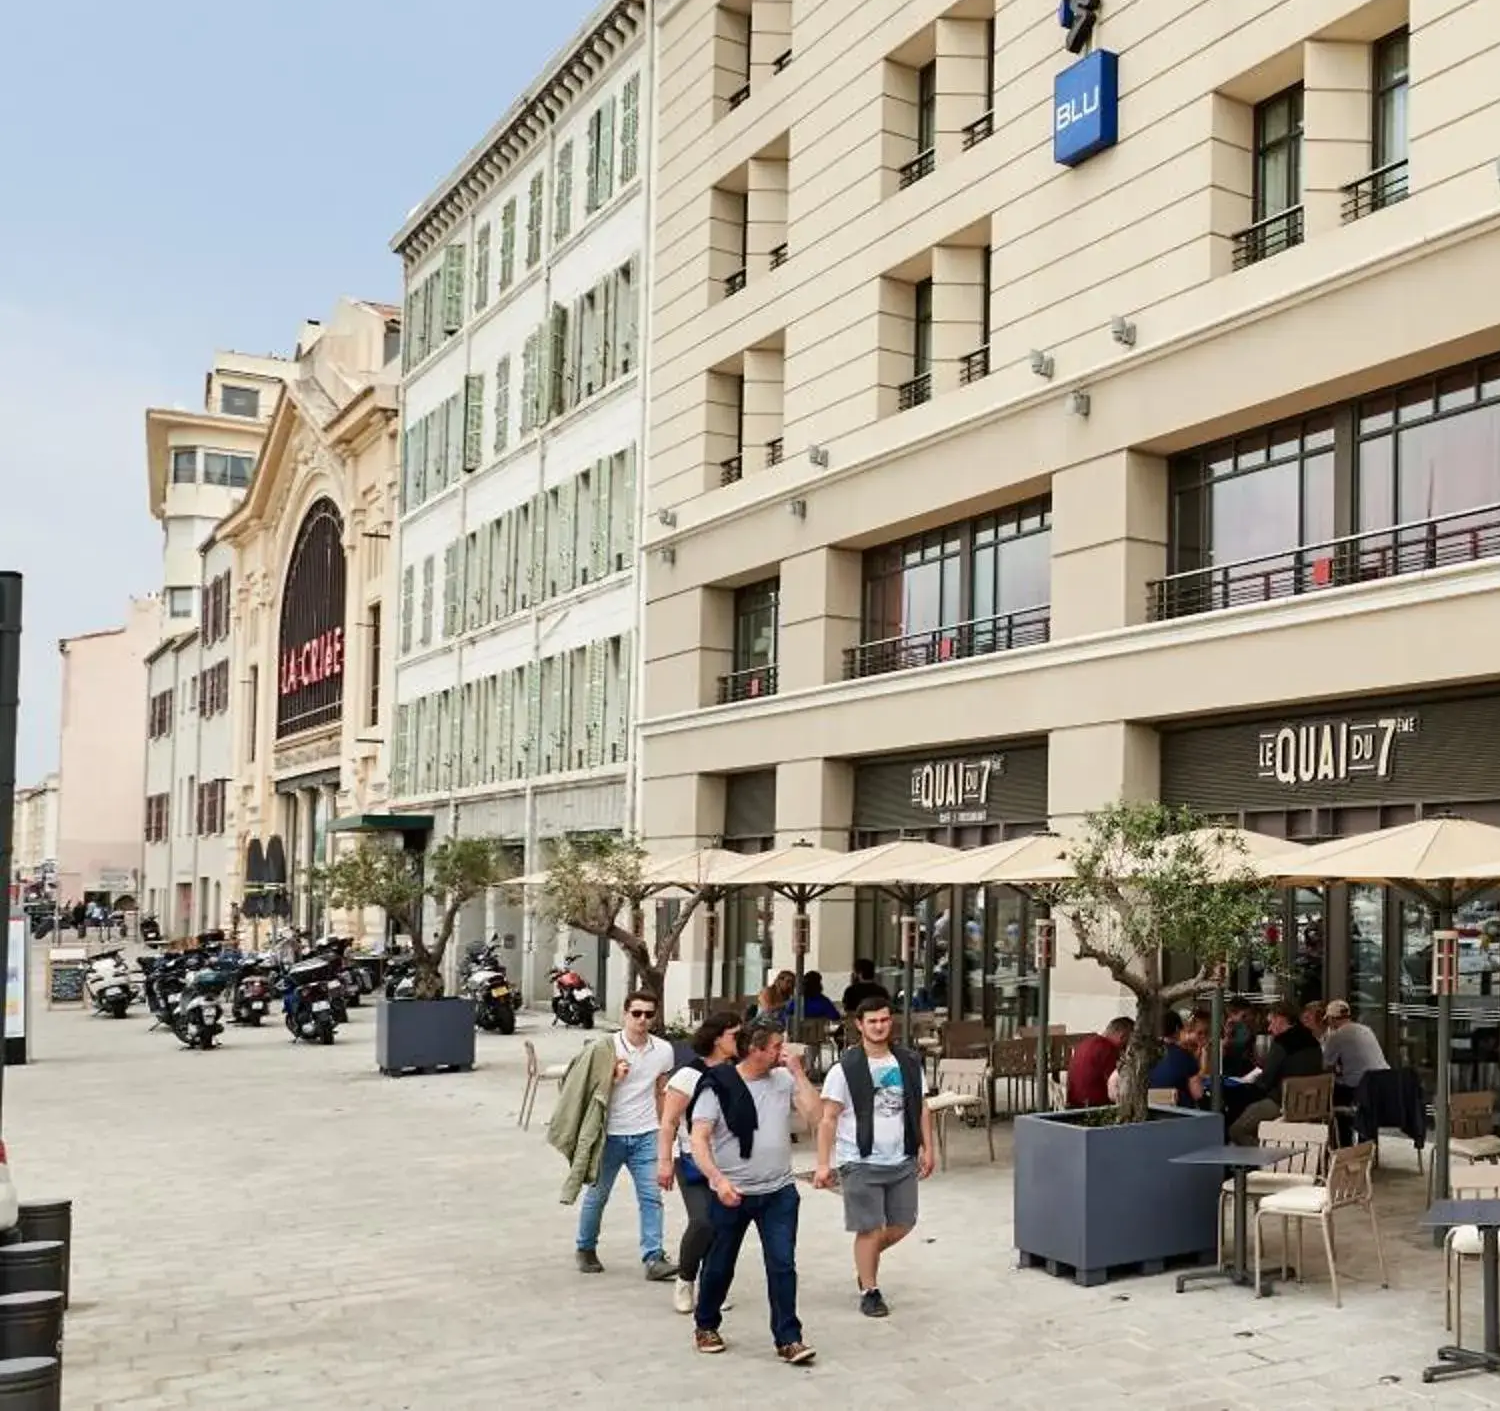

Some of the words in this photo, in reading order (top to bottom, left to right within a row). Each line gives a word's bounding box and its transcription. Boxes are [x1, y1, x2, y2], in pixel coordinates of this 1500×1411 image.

[1055, 84, 1100, 132] BLU
[281, 648, 297, 695] LA
[1258, 742, 1274, 767] LE
[1275, 722, 1348, 784] QUAI
[1352, 734, 1373, 760] DU
[921, 762, 964, 808] QUAI
